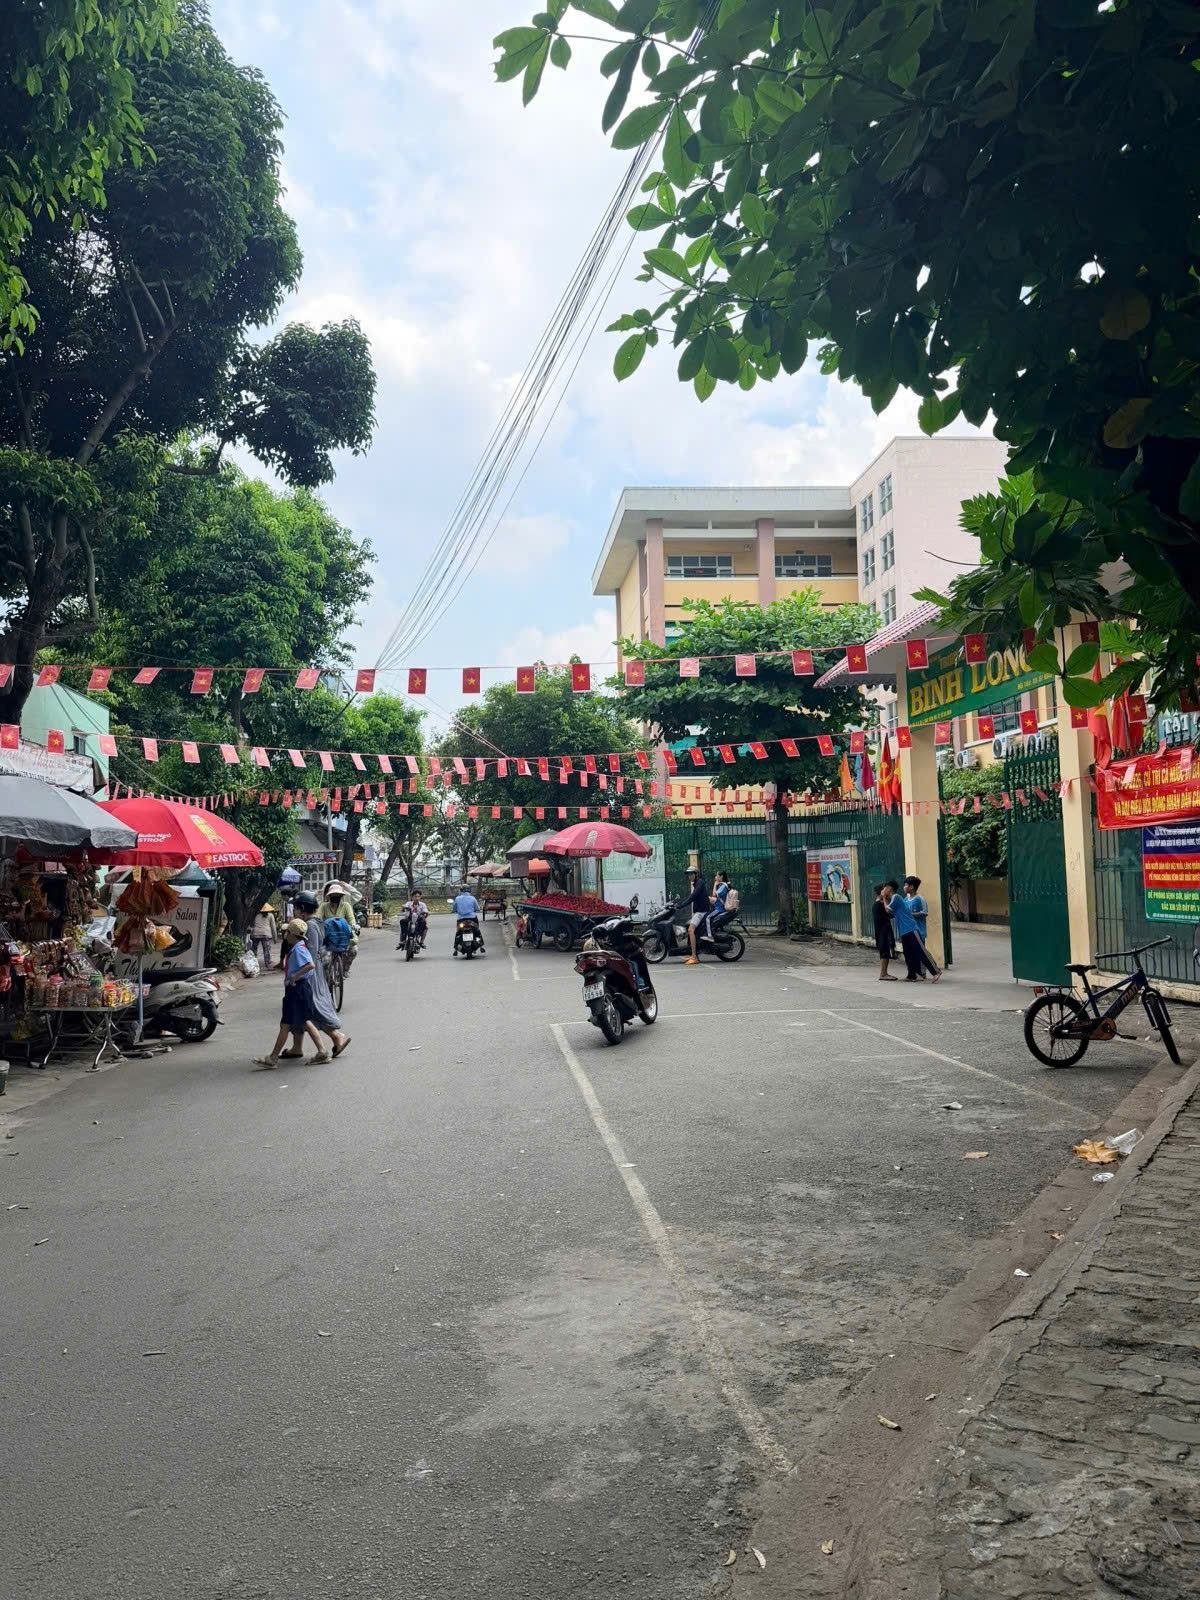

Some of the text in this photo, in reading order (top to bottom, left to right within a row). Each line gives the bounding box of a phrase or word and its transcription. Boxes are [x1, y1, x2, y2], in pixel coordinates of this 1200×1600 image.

[910, 667, 965, 717] BÌNH
[213, 853, 249, 863] EASTROC
[175, 908, 198, 921] Salon
